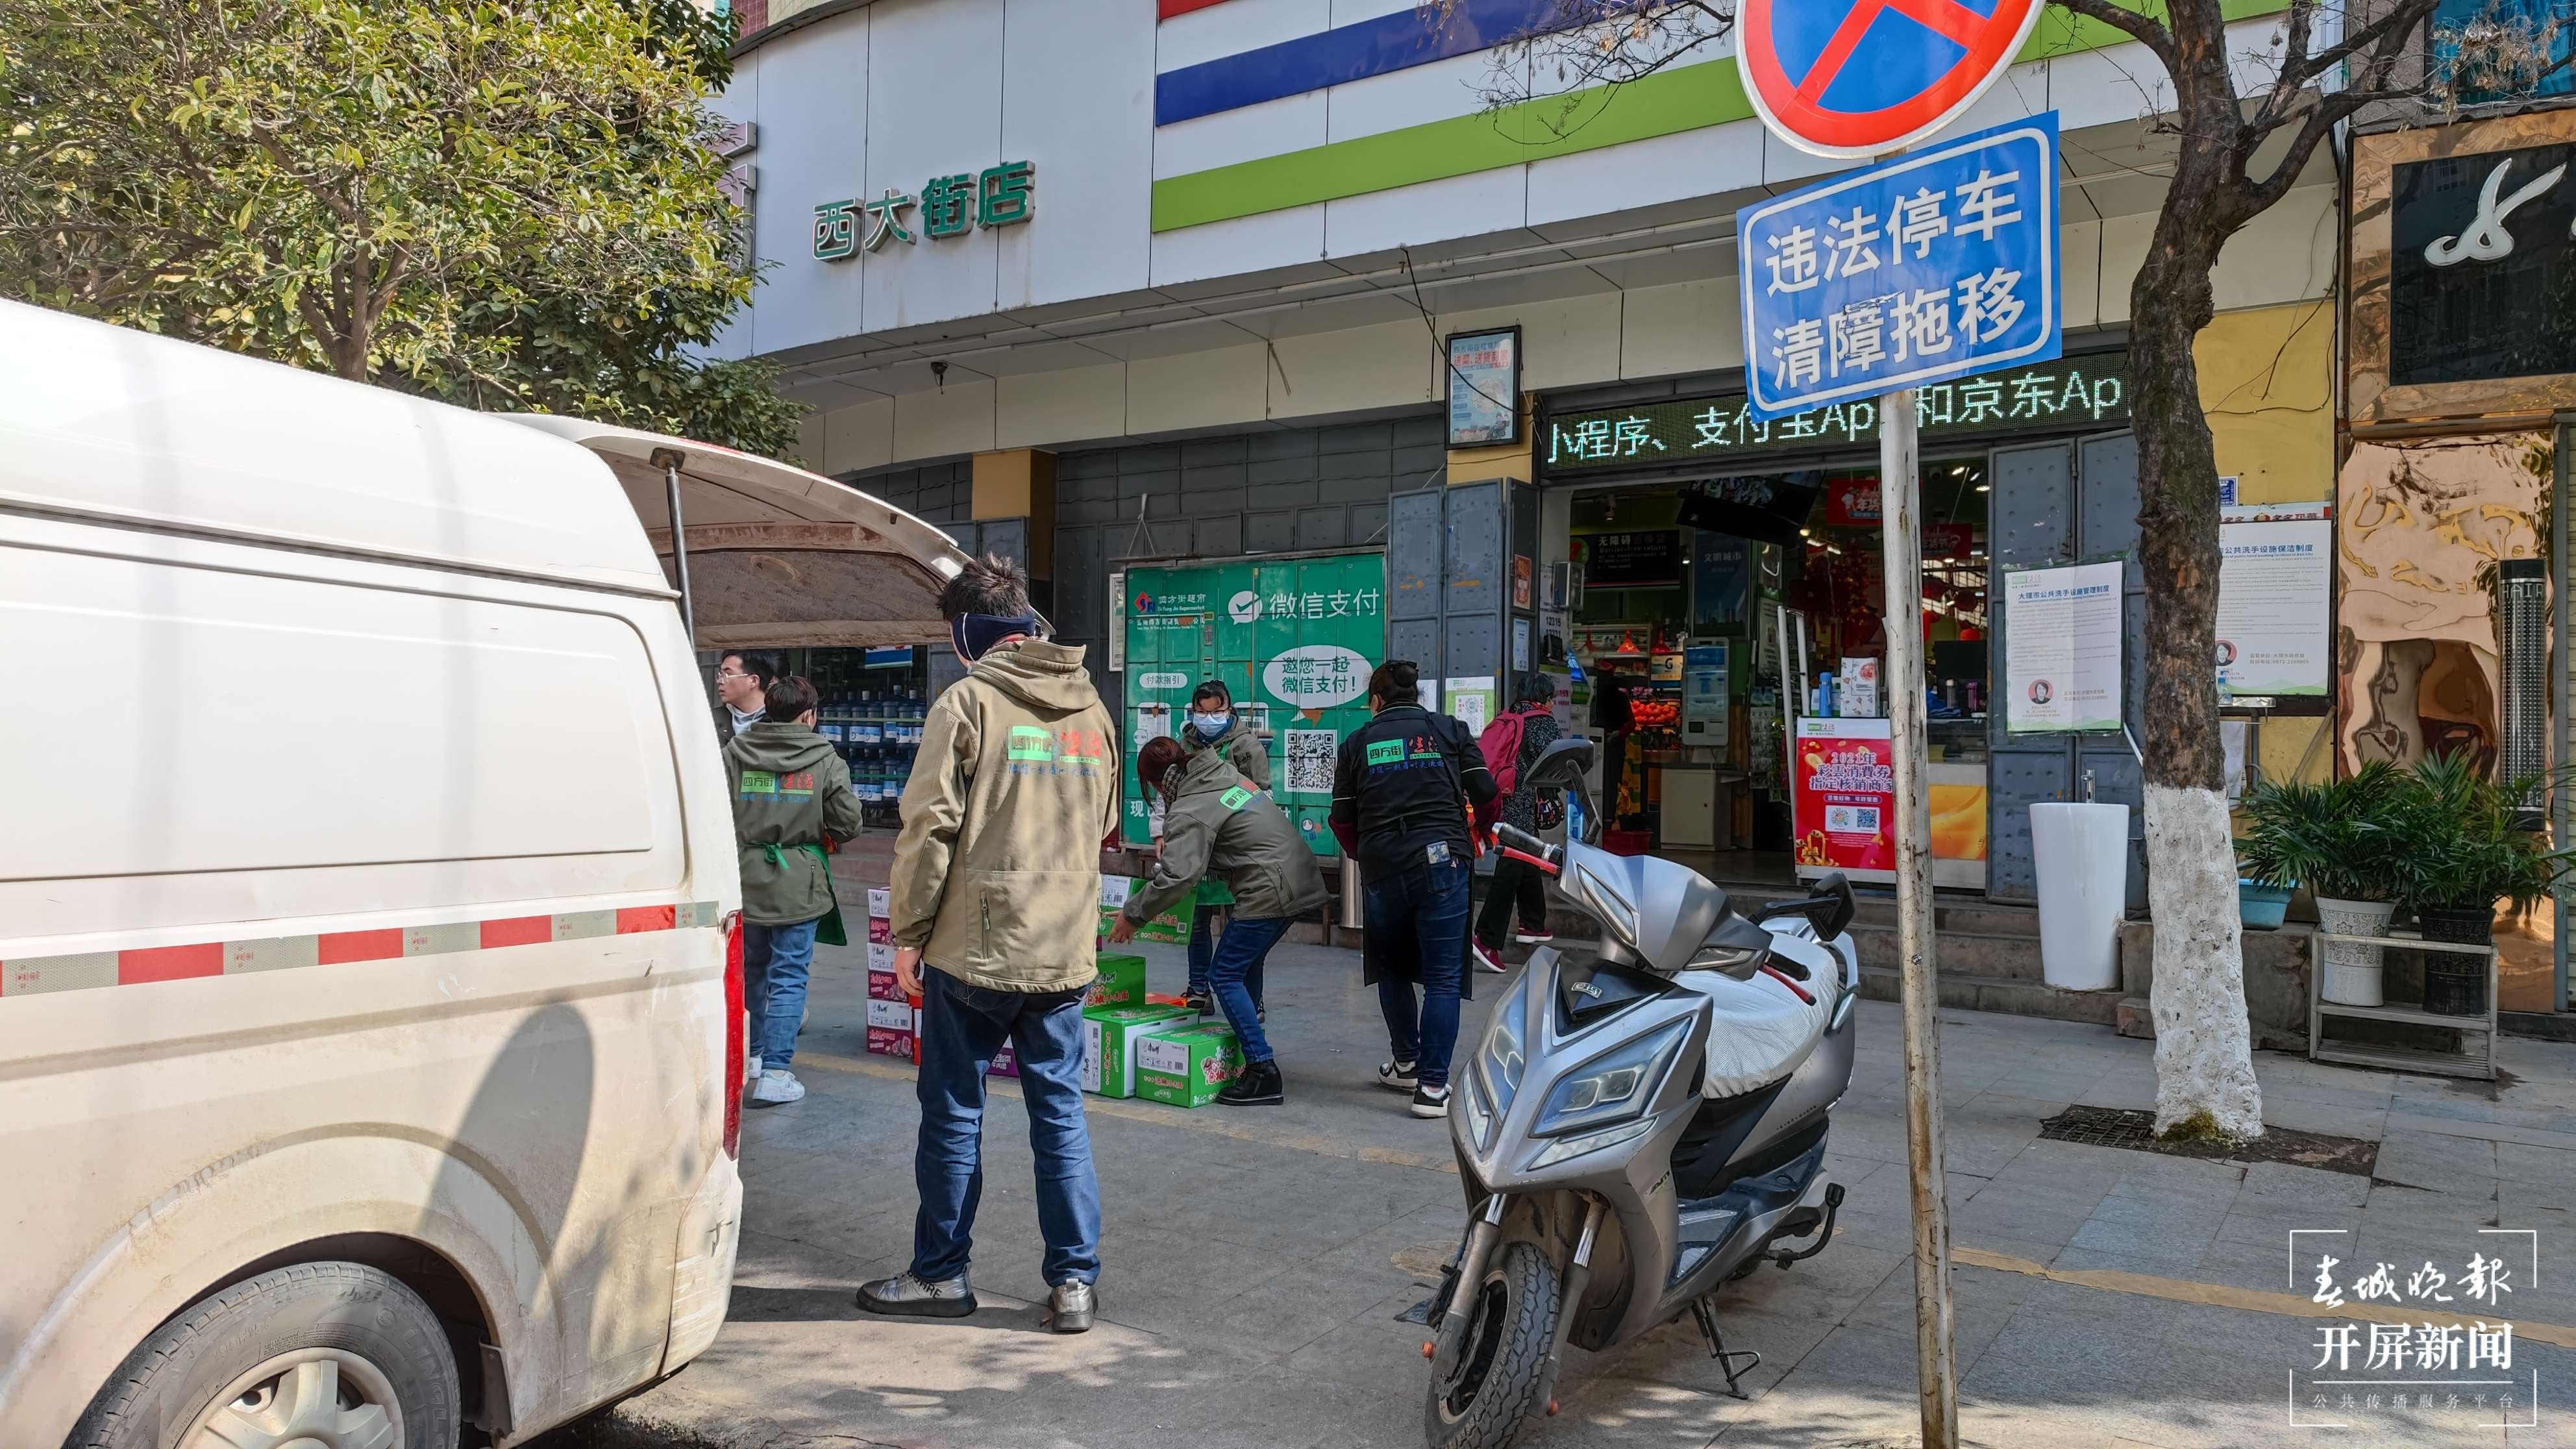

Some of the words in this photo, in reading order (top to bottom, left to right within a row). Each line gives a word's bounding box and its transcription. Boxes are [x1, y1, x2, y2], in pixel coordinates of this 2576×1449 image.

[811, 160, 1035, 262] 西大街店
[1765, 169, 2022, 298] 违法停车
[1772, 266, 2026, 391] 清障拖移
[2503, 583, 2544, 598] HAIR
[1269, 588, 1380, 621] 微信支付
[1282, 656, 1350, 675] 邀您一起
[1146, 675, 1180, 685] 付款指引
[1370, 745, 1402, 760] 四方街
[1831, 752, 1877, 765] 2021年
[743, 776, 774, 787] 四方街
